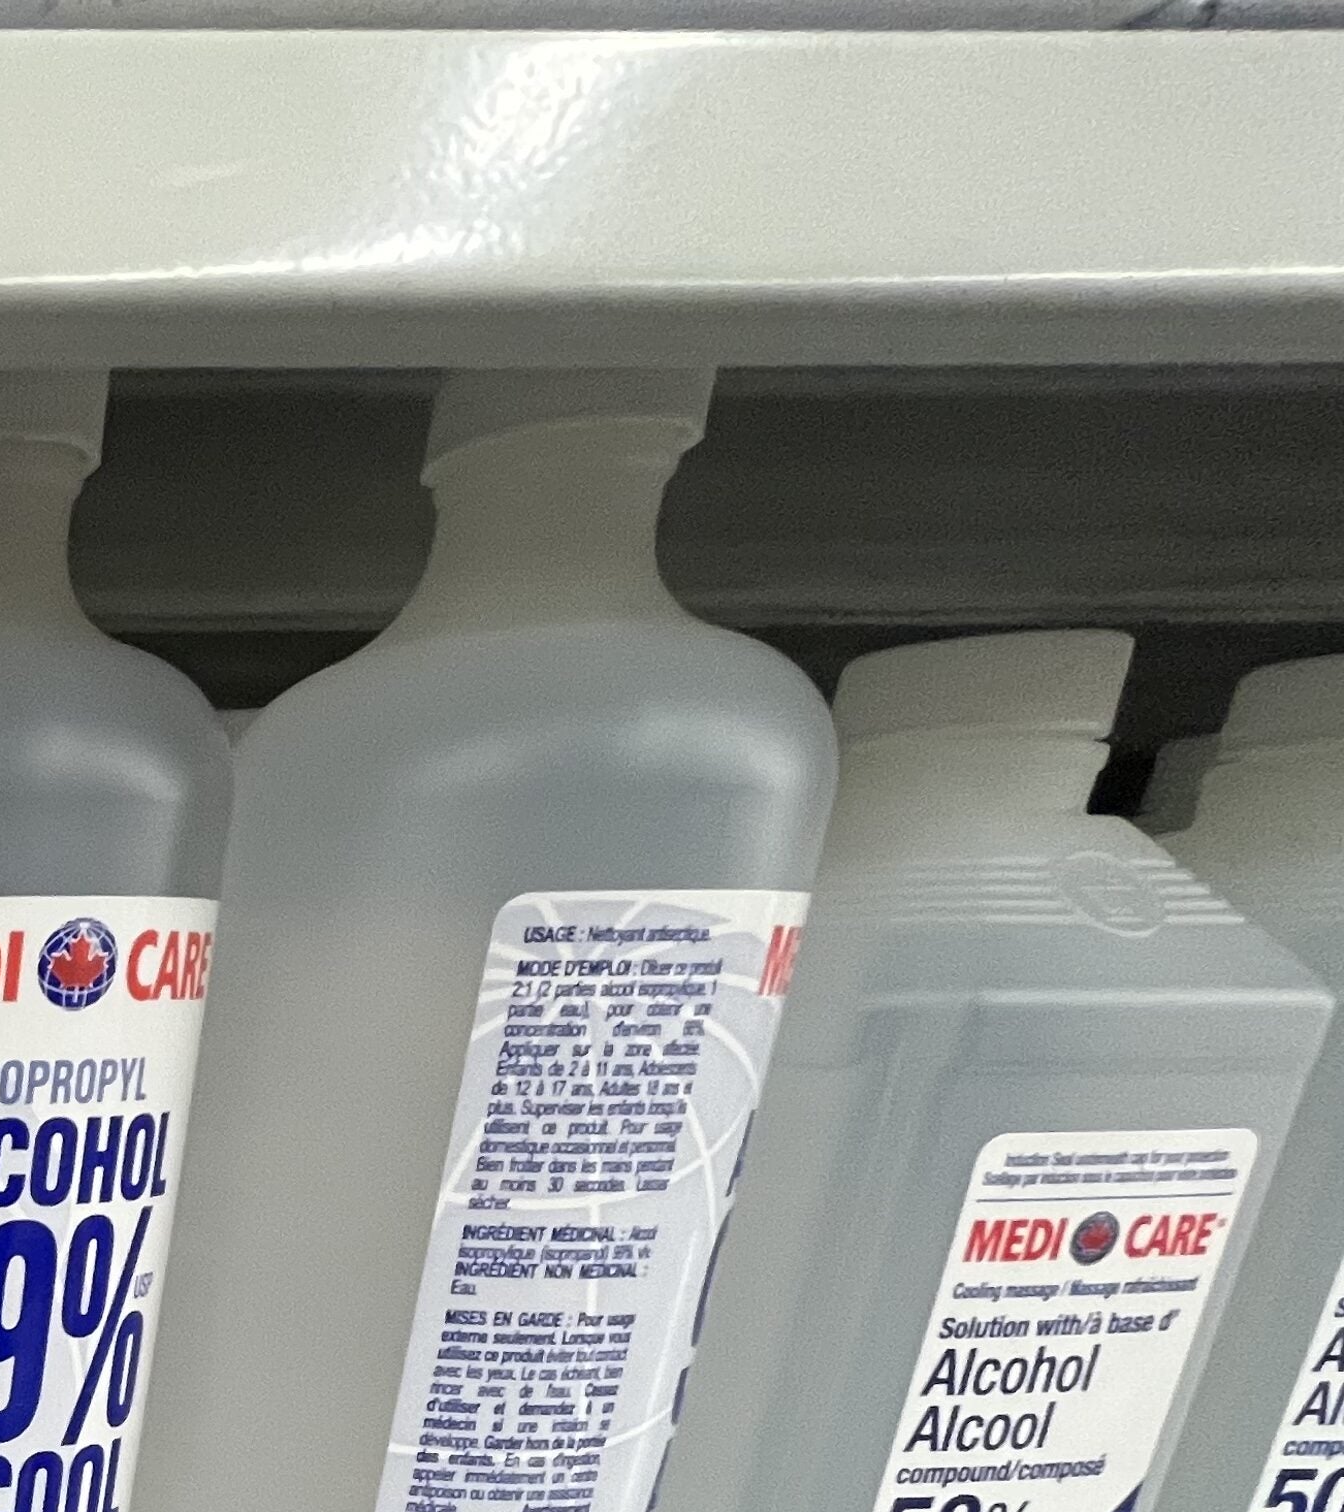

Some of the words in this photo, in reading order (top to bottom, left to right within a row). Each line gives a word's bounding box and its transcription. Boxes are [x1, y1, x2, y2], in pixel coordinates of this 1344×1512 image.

[126, 930, 213, 1002] CARE
[962, 1218, 1066, 1264] MEDI
[1123, 1212, 1217, 1257] CARE
[939, 1316, 1029, 1340] Solution
[920, 1344, 1100, 1396] Alcohol
[903, 1402, 1055, 1452] Alcool
